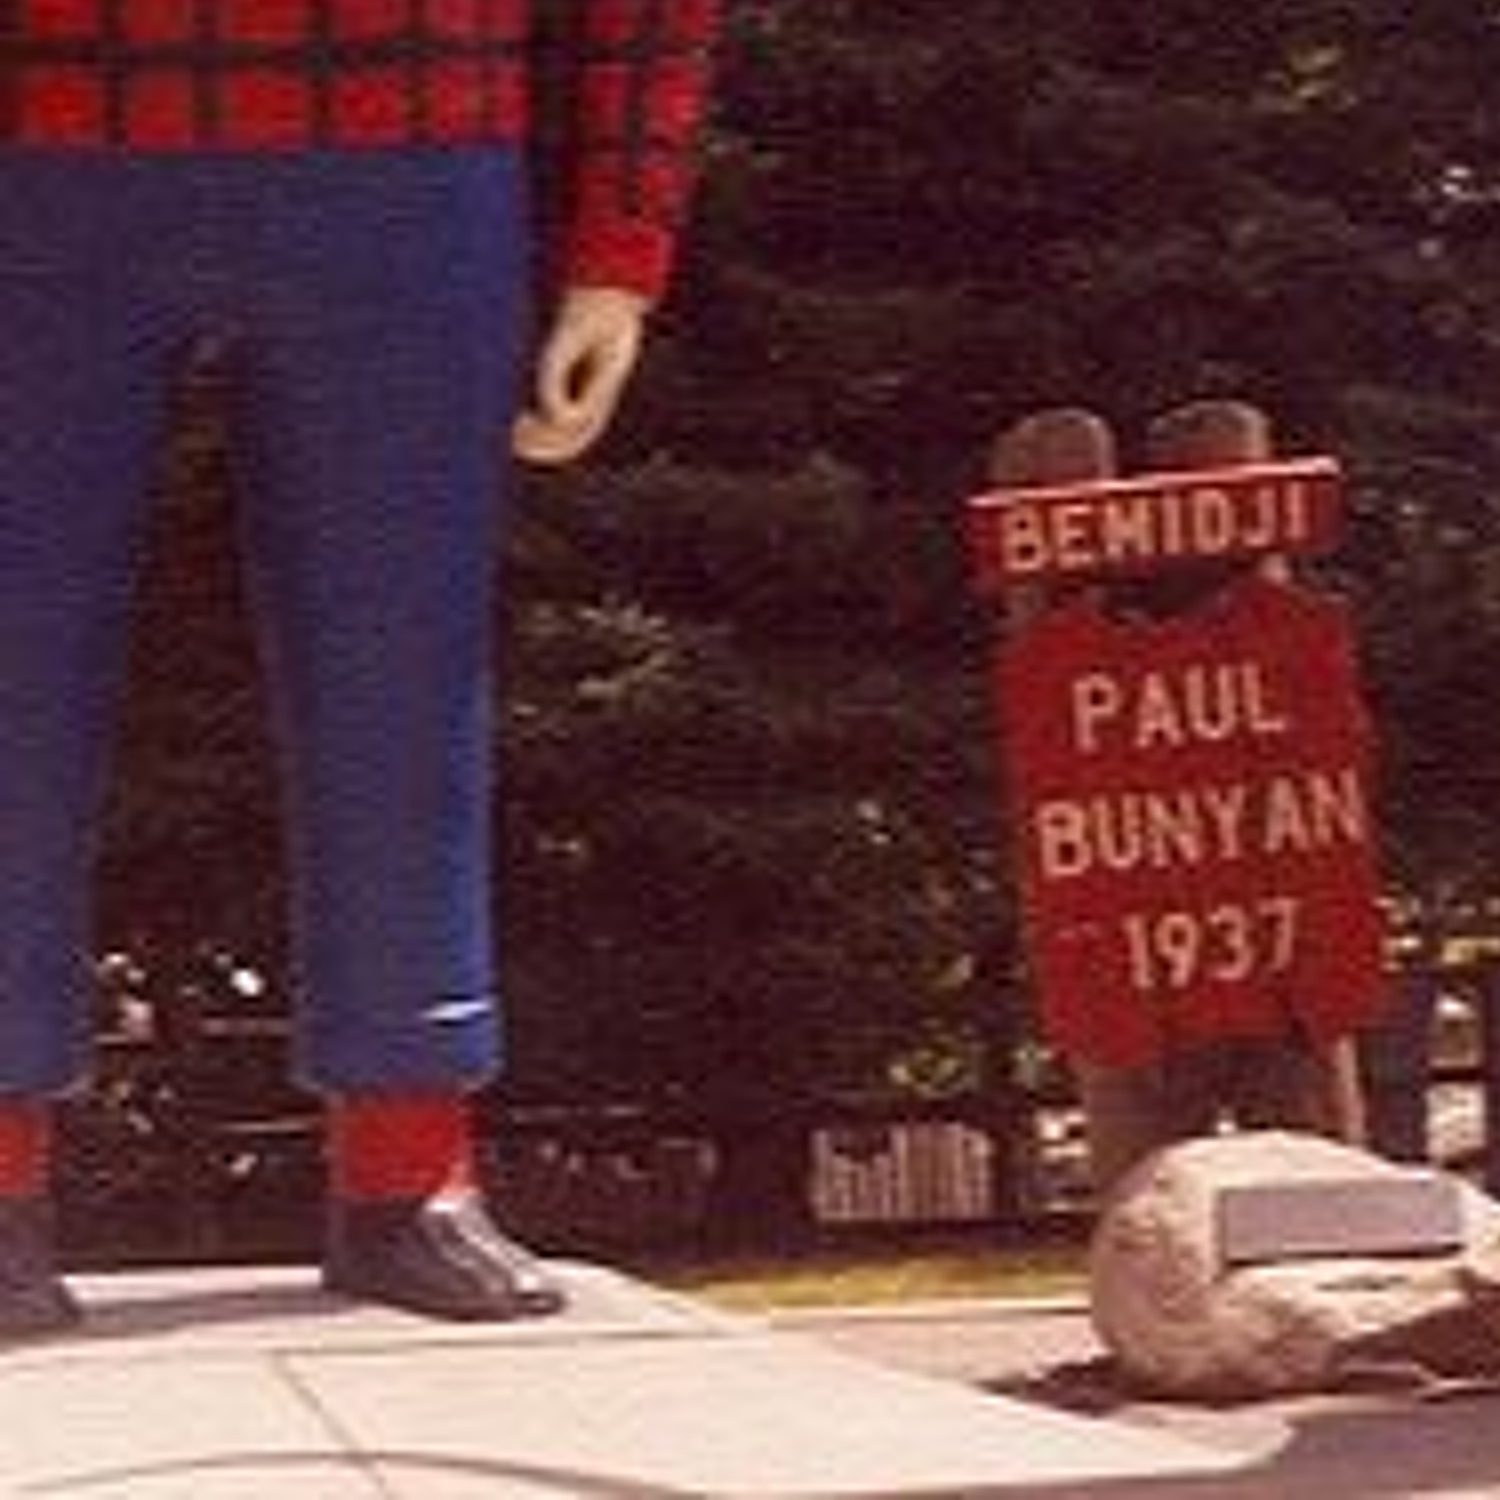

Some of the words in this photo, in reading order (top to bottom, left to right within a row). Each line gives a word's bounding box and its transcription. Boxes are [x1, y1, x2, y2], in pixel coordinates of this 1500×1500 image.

[1003, 483, 1307, 572] BEMIDJI
[1071, 662, 1286, 752] PAUL
[1037, 769, 1365, 878] BUNYAN
[1122, 897, 1298, 989] 1937
